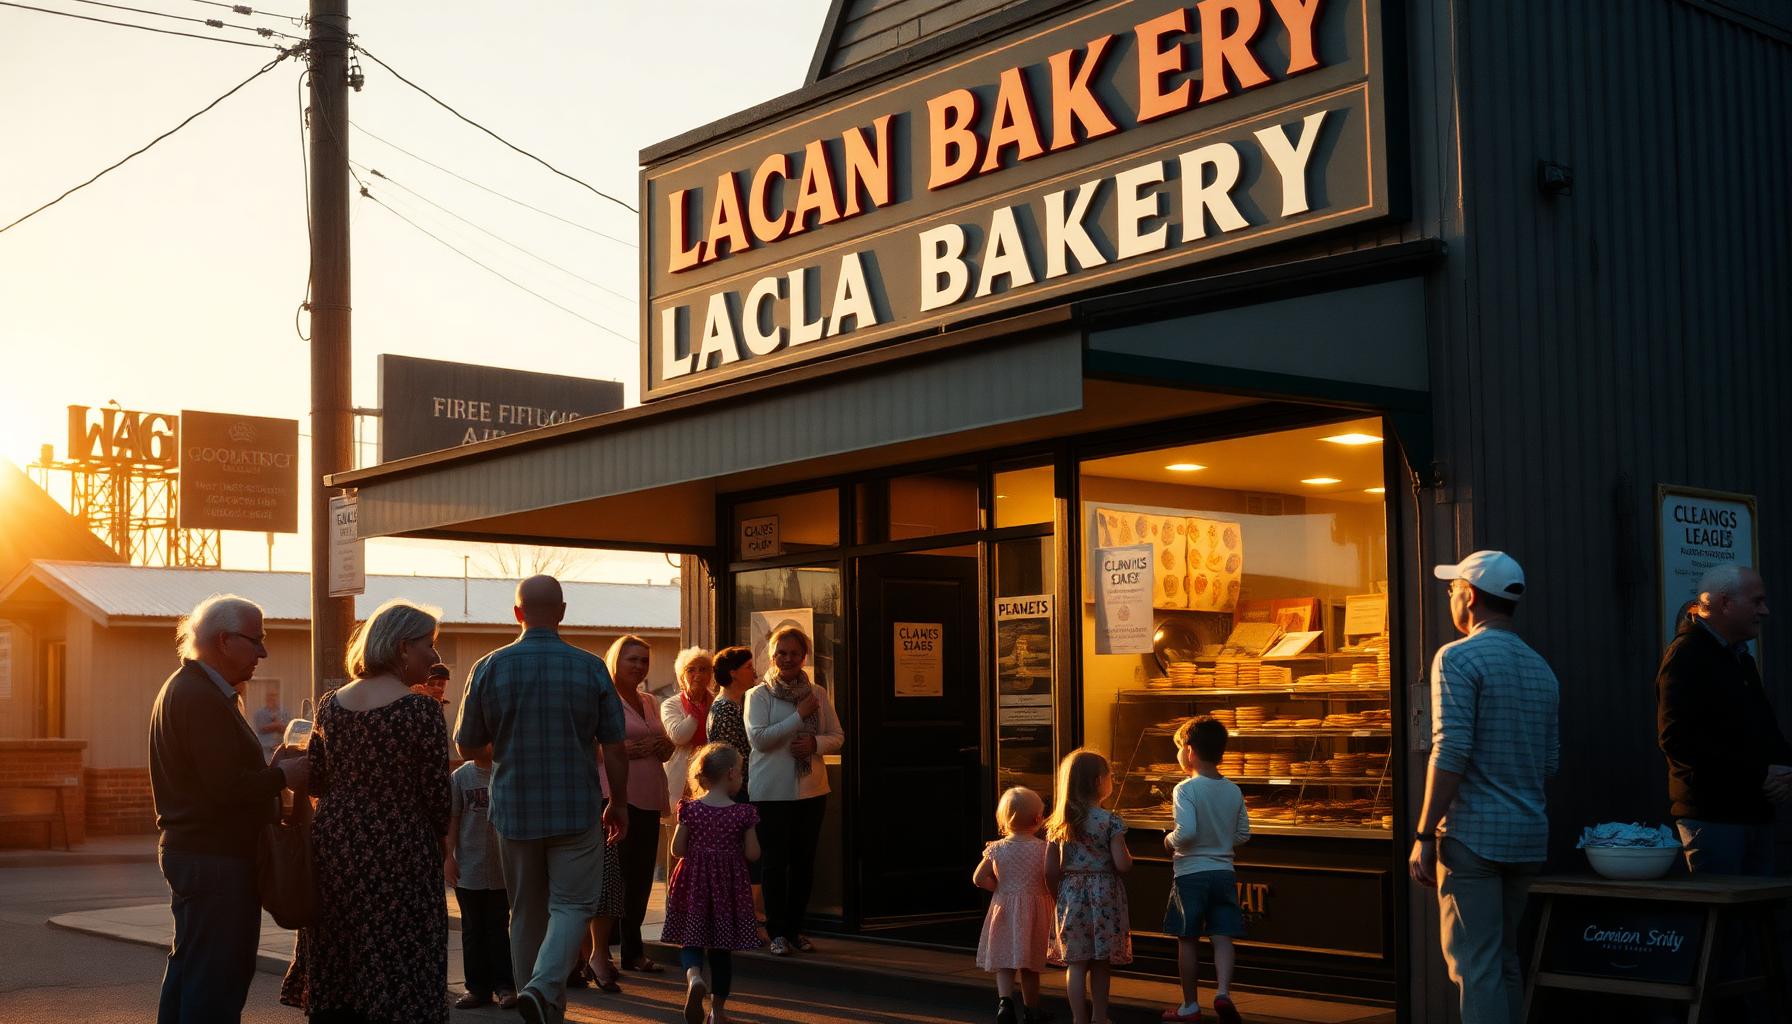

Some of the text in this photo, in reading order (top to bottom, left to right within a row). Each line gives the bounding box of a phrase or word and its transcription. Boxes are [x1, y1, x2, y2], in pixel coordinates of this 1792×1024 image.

[661, 110, 1330, 381] LACLA BAKERY
[667, 0, 1325, 273] LACAN BAKERY
[432, 396, 492, 422] FIREE
